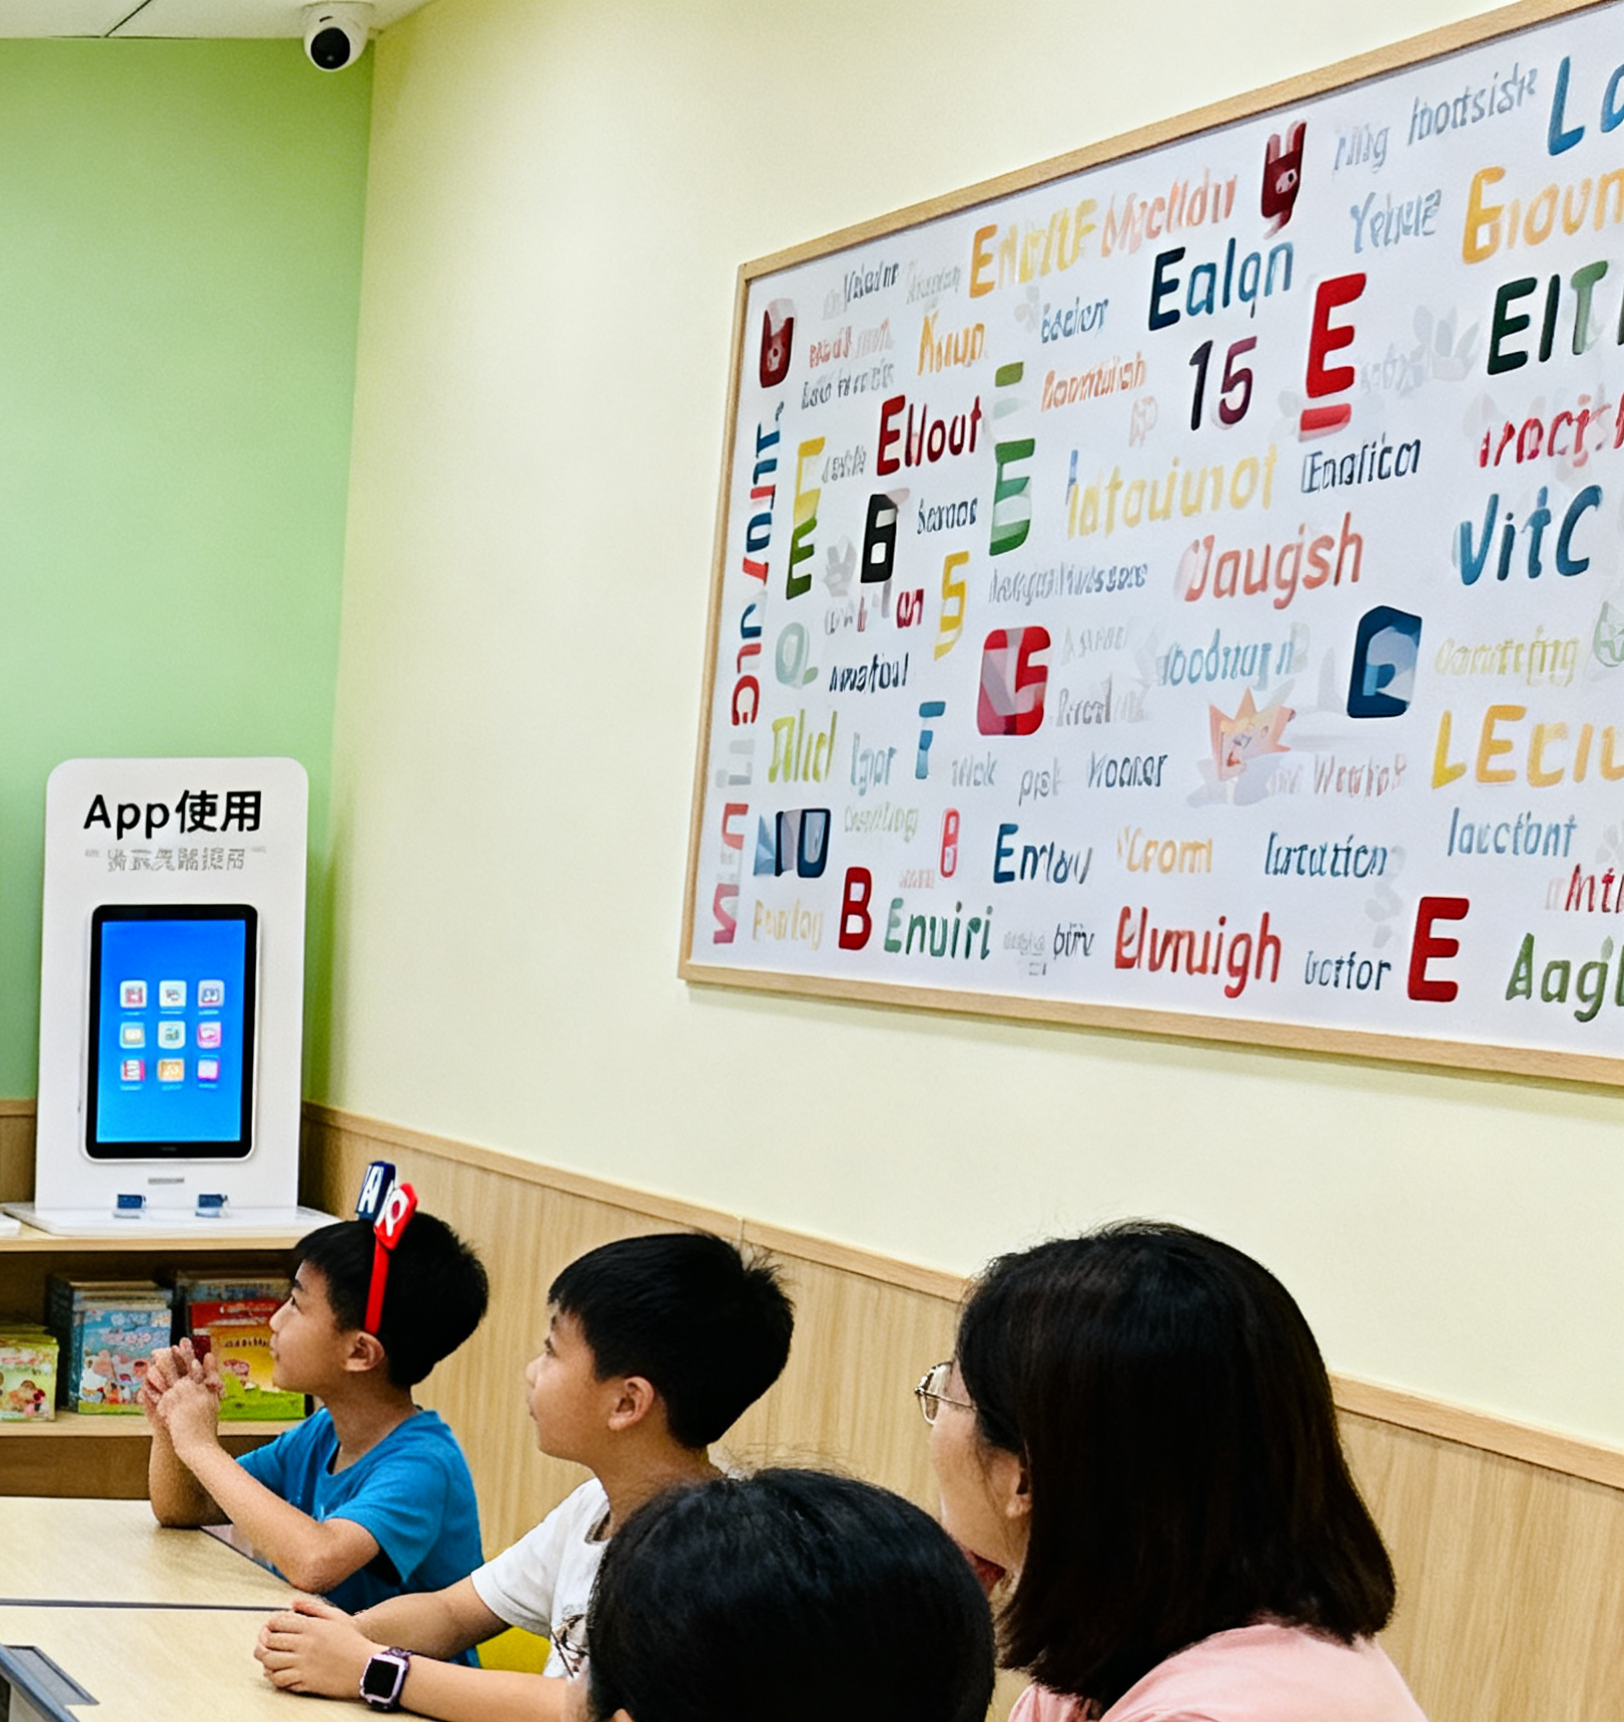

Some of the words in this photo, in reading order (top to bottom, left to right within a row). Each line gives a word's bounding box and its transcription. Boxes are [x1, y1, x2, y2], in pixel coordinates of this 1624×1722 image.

[1188, 335, 1258, 432] 15
[82, 788, 264, 840] App使用
[838, 866, 873, 951] B
[1407, 896, 1471, 1004] E
